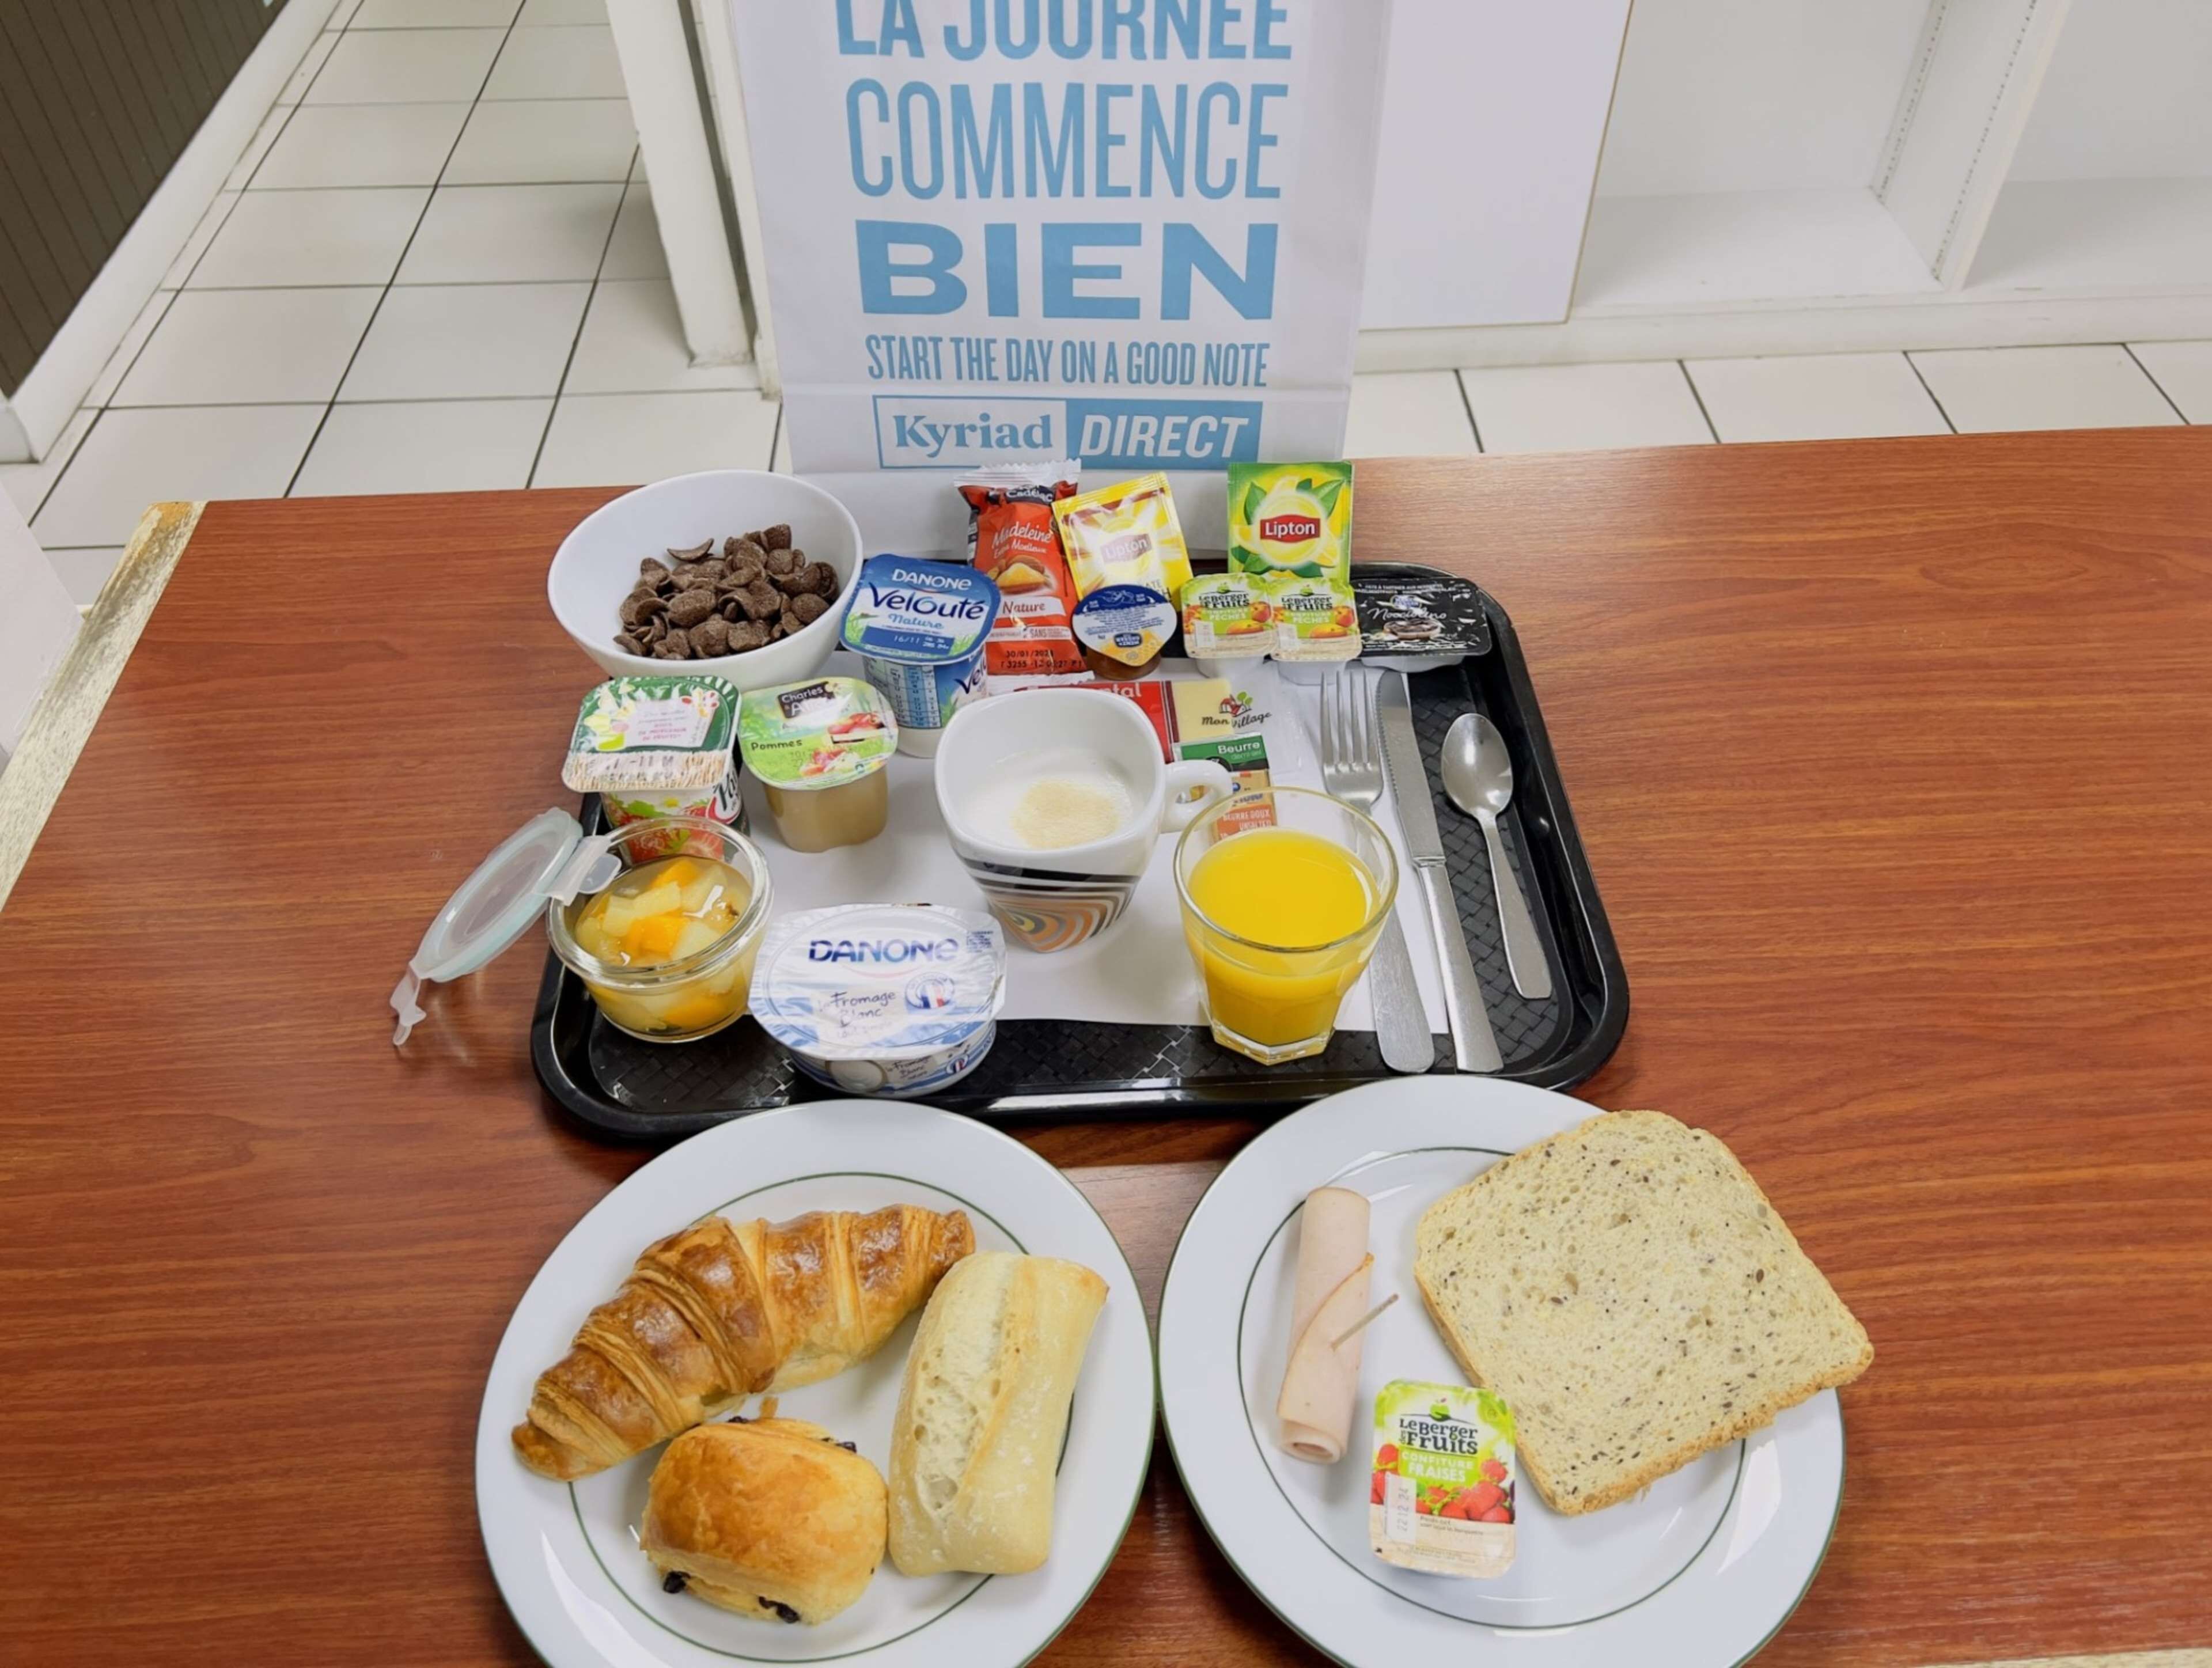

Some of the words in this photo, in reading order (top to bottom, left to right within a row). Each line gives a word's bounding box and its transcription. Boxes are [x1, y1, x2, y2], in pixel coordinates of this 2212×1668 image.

[837, 0, 925, 58] LA
[845, 77, 1289, 200] COMMENCE
[855, 219, 1279, 321] BIEN
[865, 334, 943, 380] START
[949, 336, 999, 381] THE
[1005, 338, 1054, 382] DAY
[1061, 340, 1096, 383] ON
[1103, 342, 1119, 384] A
[1127, 341, 1196, 385] GOOD
[1203, 343, 1271, 387] NOTE
[892, 412, 1053, 458] Kyriad
[1078, 414, 1249, 458] DIRECT
[991, 521, 1054, 549] Madeleine
[1264, 521, 1316, 539] Lipton
[1104, 537, 1148, 559] Lipton
[868, 582, 986, 620] Velouté
[1002, 601, 1046, 614] Nature
[1204, 599, 1250, 609] Fruits
[887, 613, 944, 630] Nature
[781, 686, 824, 703] Charles
[1201, 716, 1230, 726] Mon
[1230, 711, 1272, 729] Village
[750, 739, 803, 750] Pommes
[1217, 741, 1260, 754] Beurre
[1250, 808, 1271, 818] DOUX
[830, 991, 897, 1007] Fromage
[1418, 1421, 1479, 1441] Berger
[1407, 1430, 1479, 1455] Fruits
[1401, 1451, 1475, 1469] CONFITURE
[1408, 1462, 1467, 1483] FRAISES
